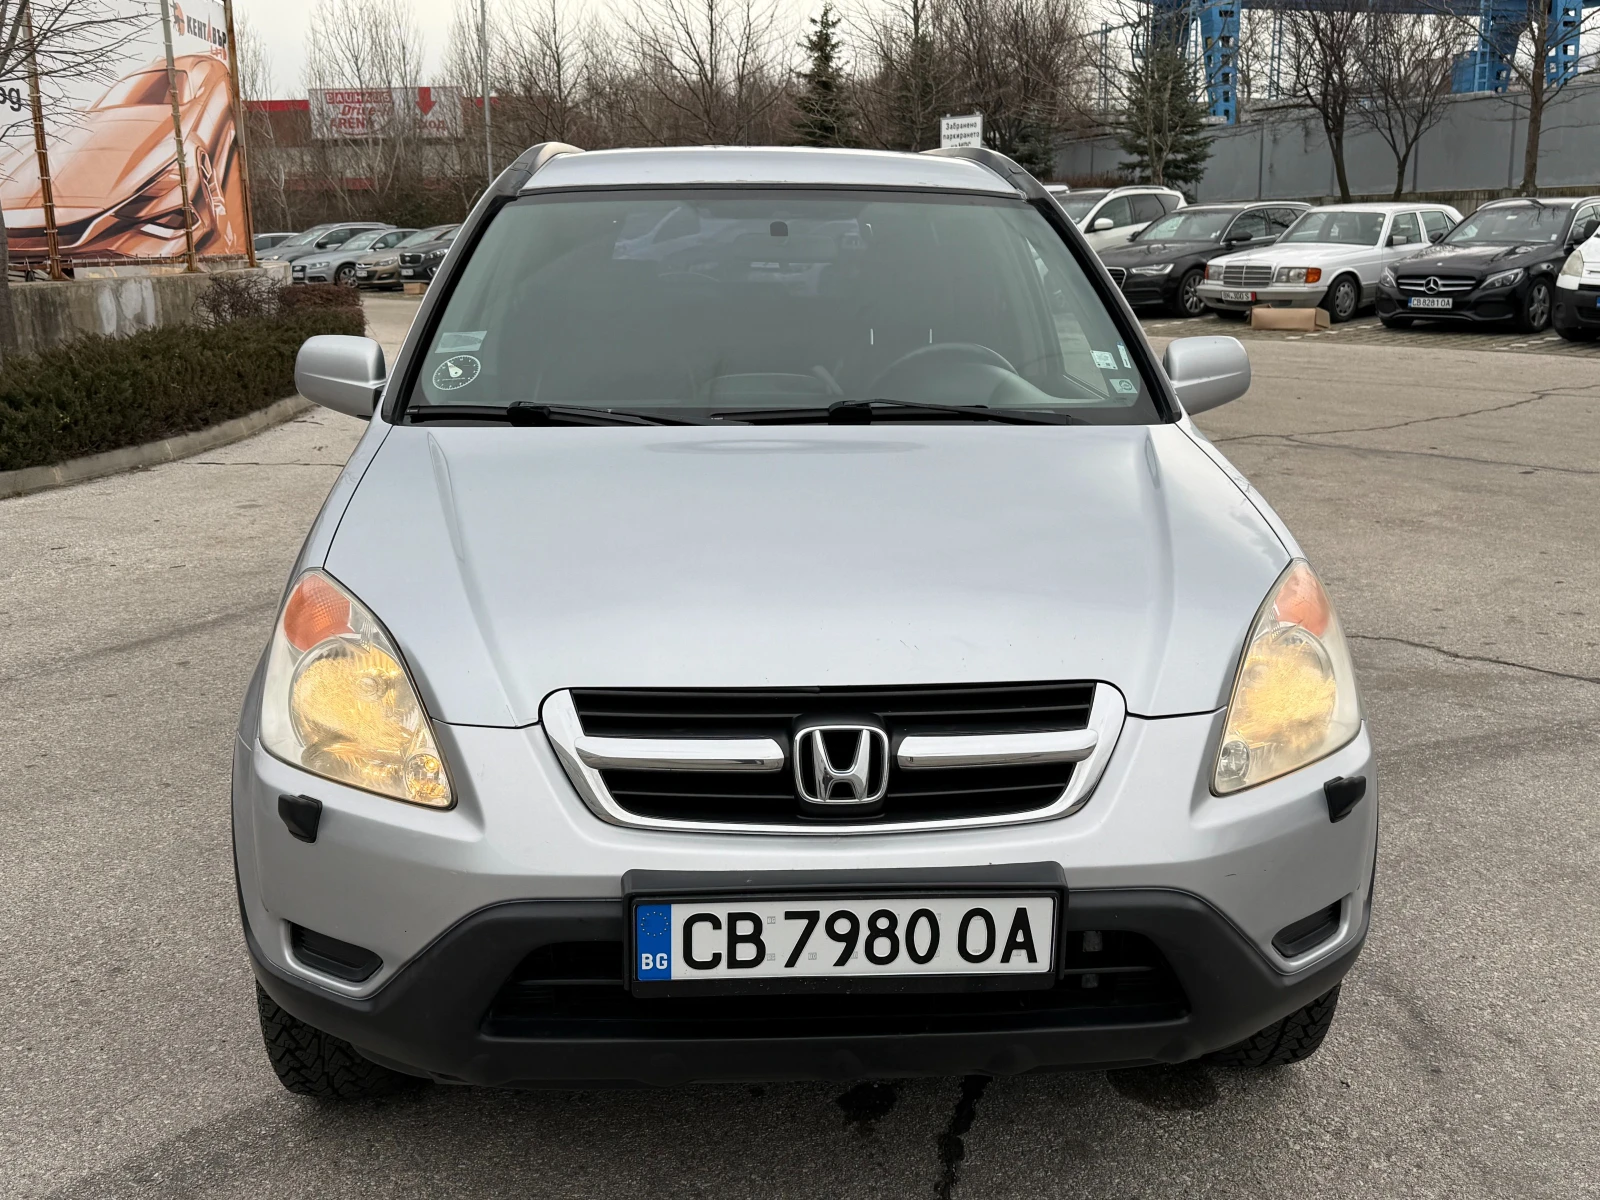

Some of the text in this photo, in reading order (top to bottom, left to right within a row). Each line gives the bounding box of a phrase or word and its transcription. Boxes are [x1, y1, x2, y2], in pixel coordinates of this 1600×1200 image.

[325, 92, 391, 103] BAUHAUS
[945, 122, 977, 131] Забранено
[682, 907, 1038, 971] CB 7980 OA
[641, 953, 668, 970] BG
